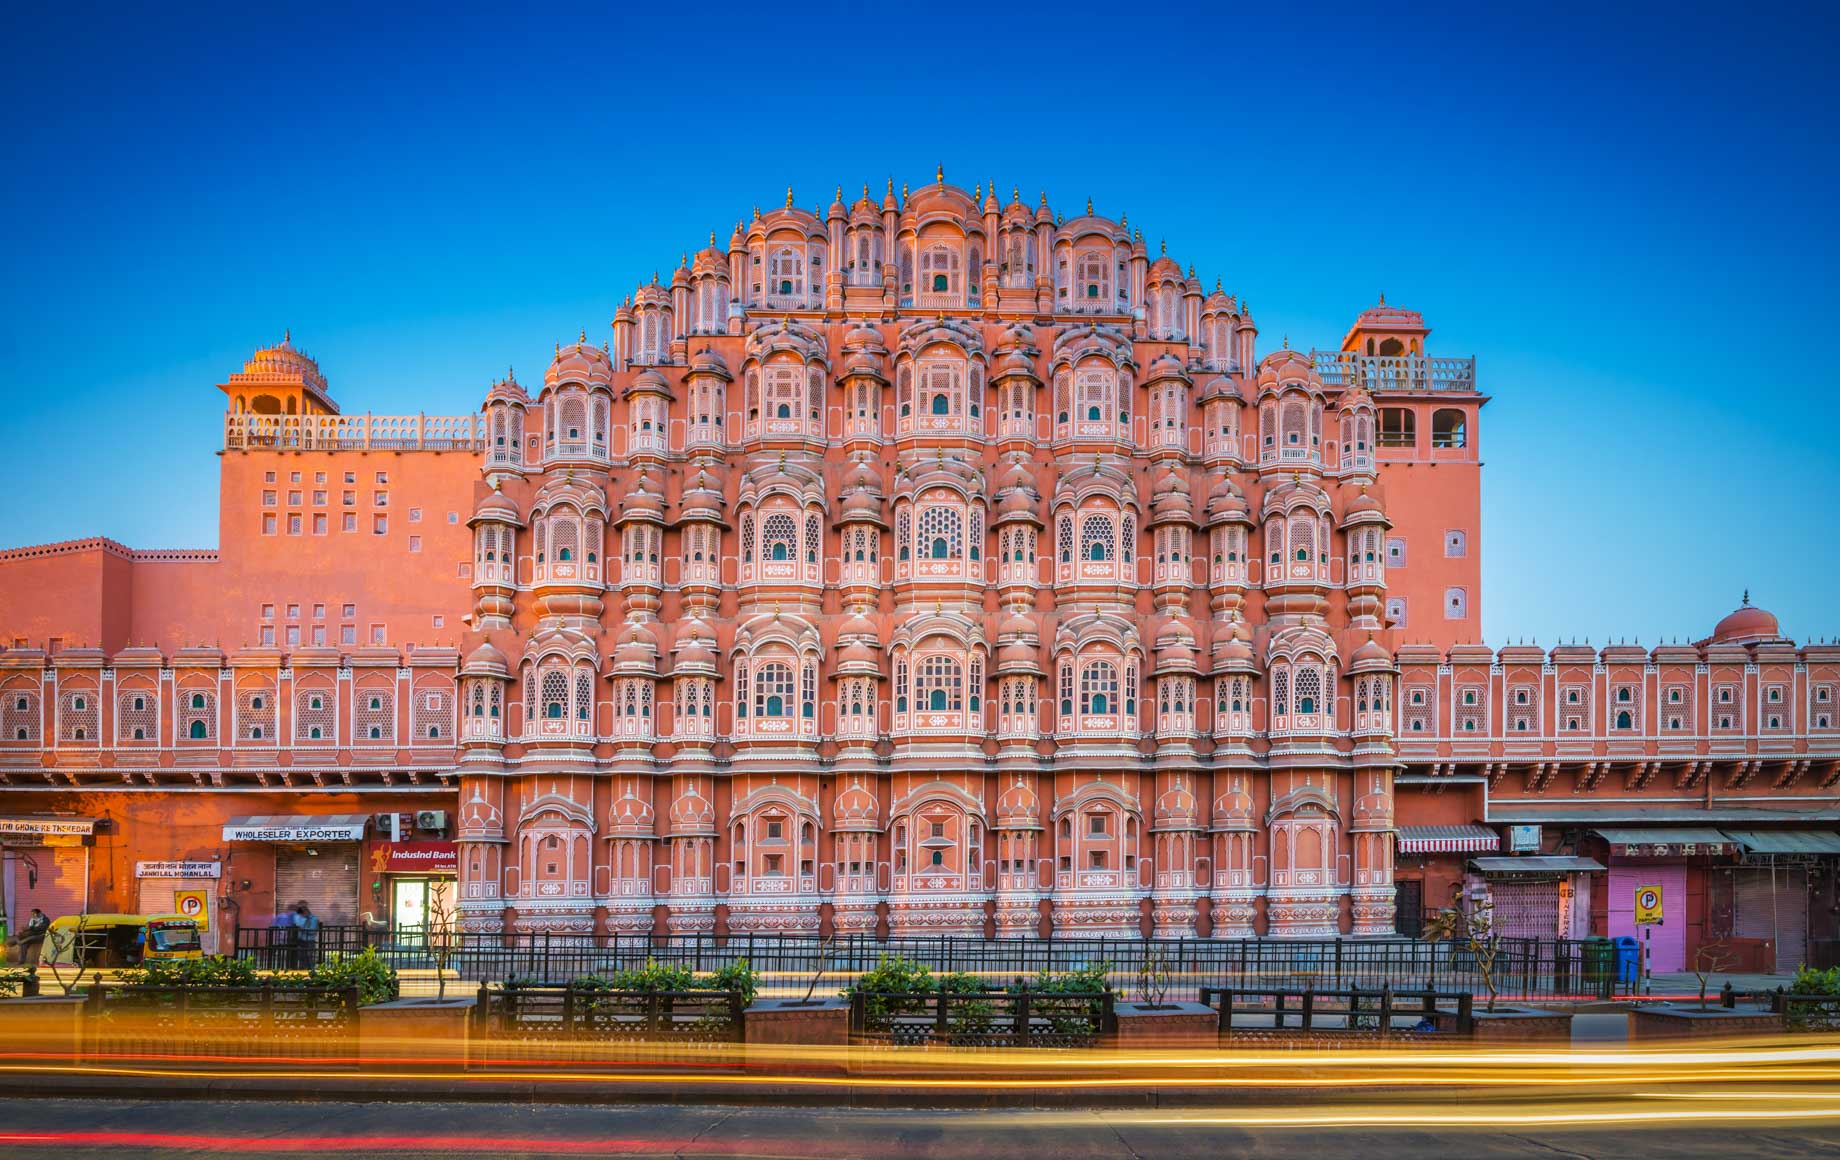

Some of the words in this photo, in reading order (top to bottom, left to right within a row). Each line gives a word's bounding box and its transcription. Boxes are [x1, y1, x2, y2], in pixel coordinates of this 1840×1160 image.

[235, 831, 291, 839] WHOLESELER
[296, 830, 351, 838] EXPORTER
[392, 851, 432, 859] IndusInd
[433, 851, 456, 859] Bank
